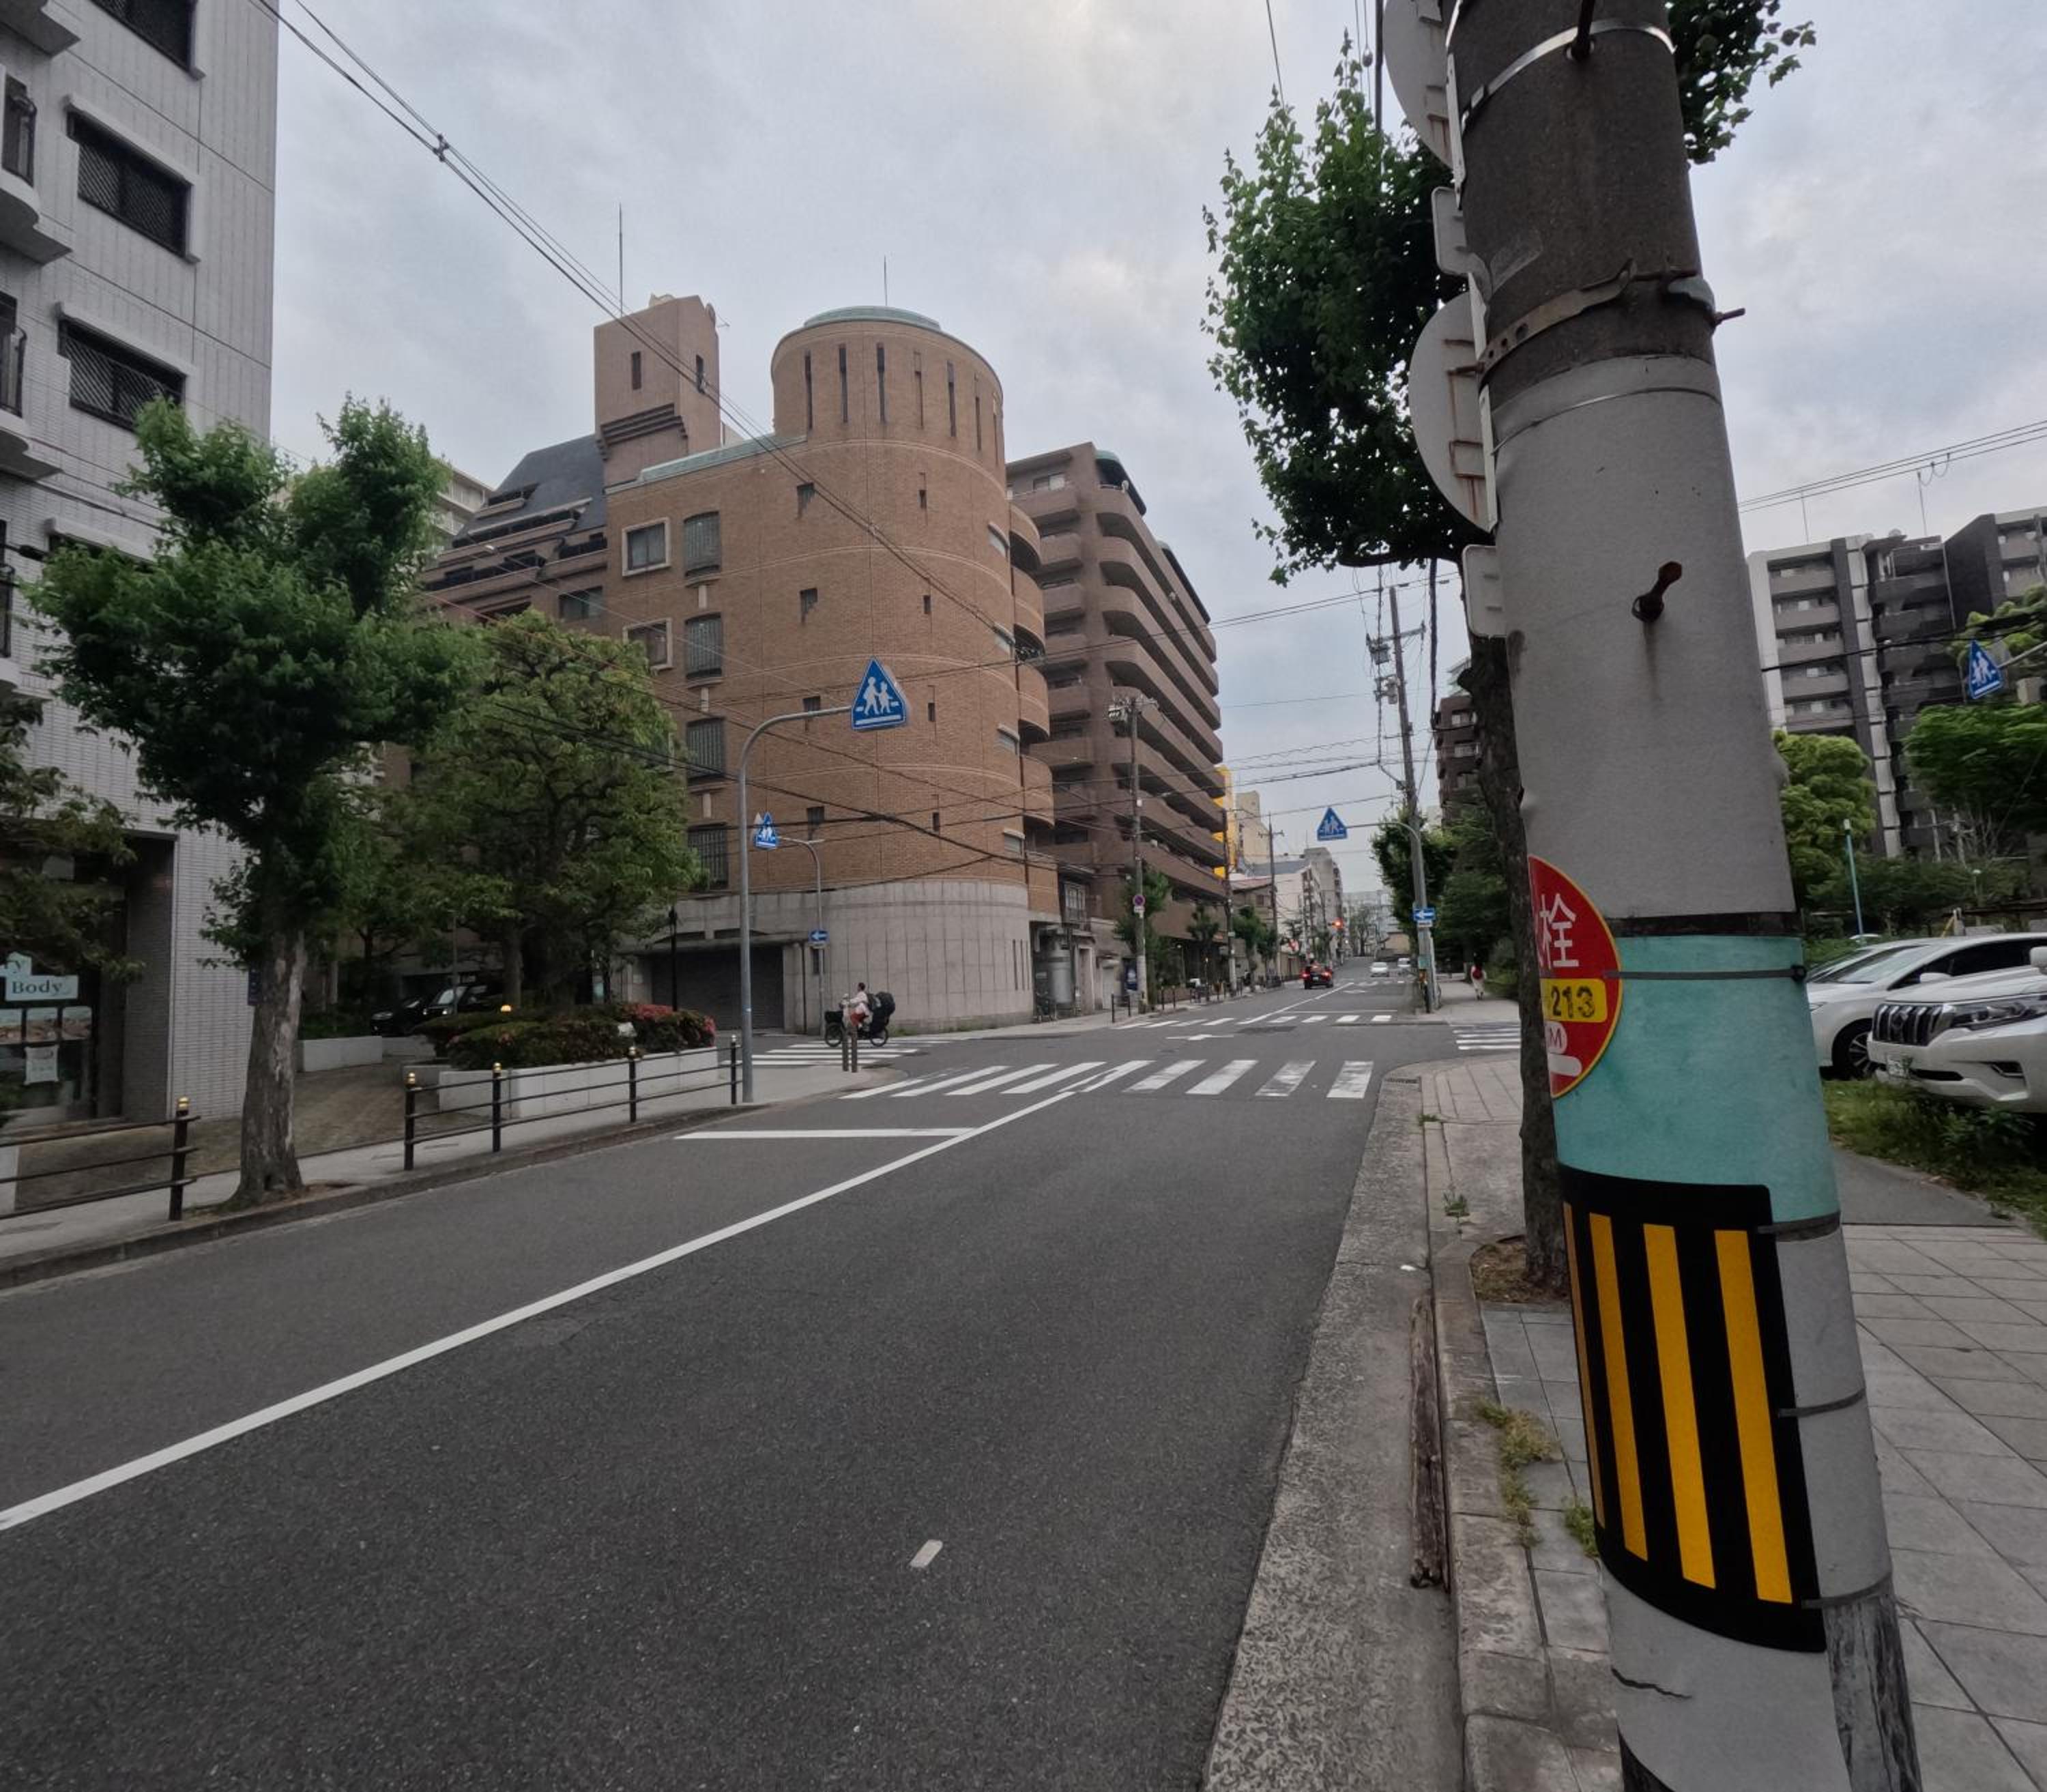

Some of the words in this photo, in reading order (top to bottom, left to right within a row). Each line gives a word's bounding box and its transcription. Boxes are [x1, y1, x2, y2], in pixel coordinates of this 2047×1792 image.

[1537, 893, 1579, 970] 栓
[12, 979, 63, 997] Body
[1550, 985, 1596, 1019] 213
